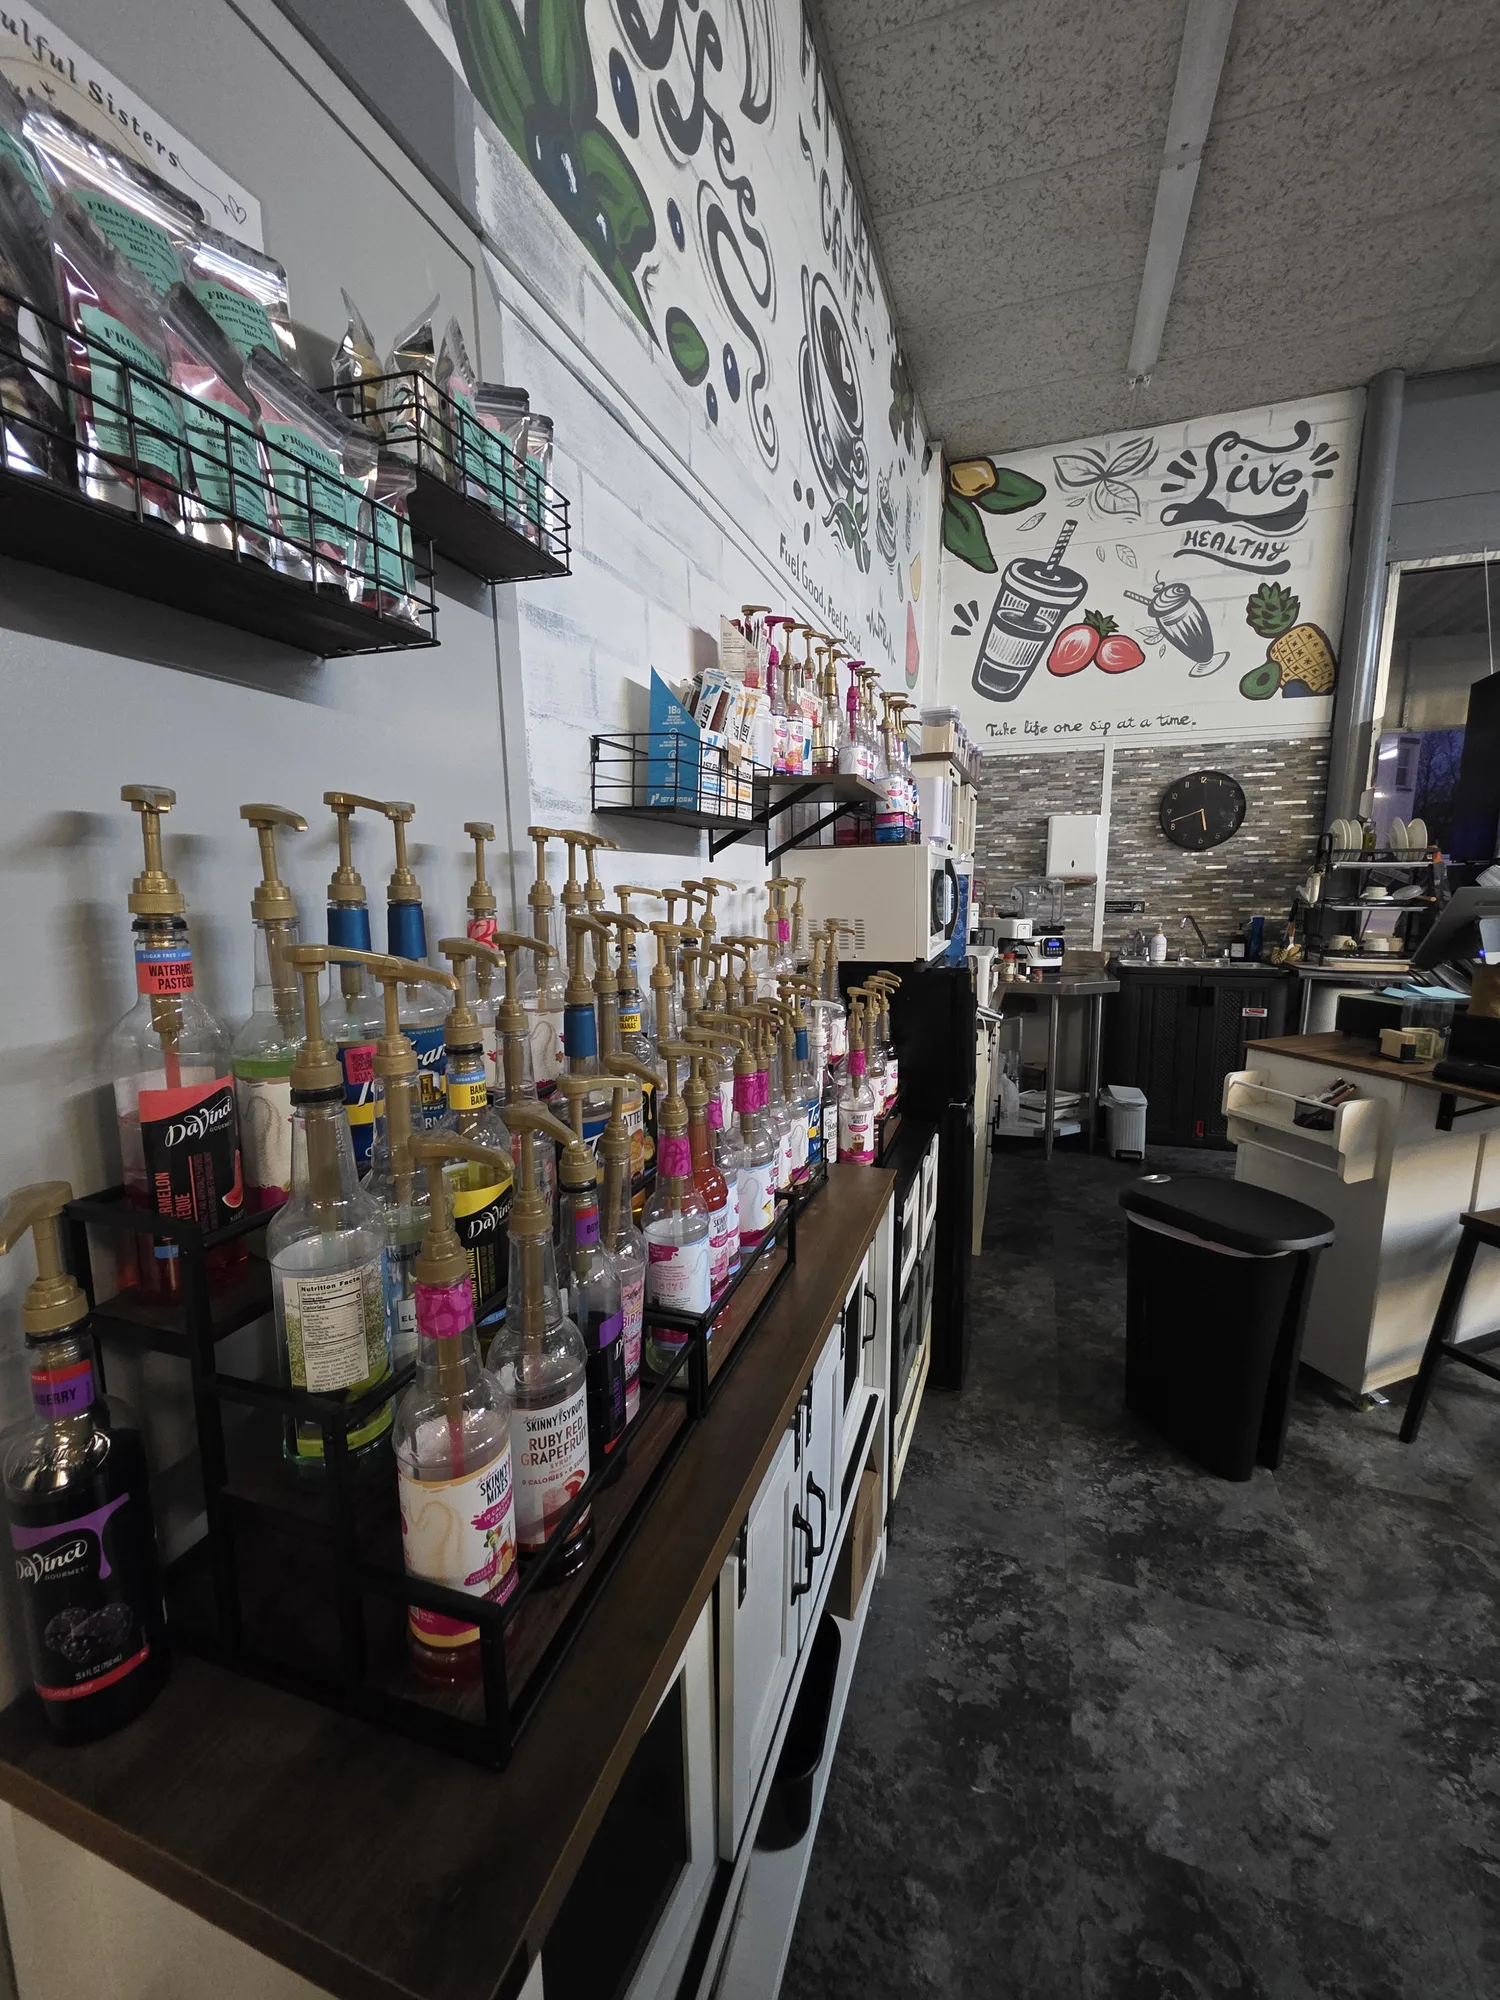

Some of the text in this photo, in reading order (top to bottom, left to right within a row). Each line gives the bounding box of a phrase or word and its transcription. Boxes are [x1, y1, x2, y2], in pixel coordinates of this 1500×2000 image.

[88, 79, 180, 167] Sisters
[818, 165, 864, 344] CAFE
[215, 313, 257, 332] Strawberry
[1160, 419, 1310, 532] Live
[1183, 530, 1290, 562] HEALTHY
[779, 532, 801, 582] Fuel
[801, 560, 827, 616] Good,
[827, 595, 843, 636] Feel
[985, 714, 1197, 737] Take life one sip at a time.
[1171, 792, 1178, 800] 10
[1229, 789, 1236, 797] 2
[1170, 823, 1176, 831] 8
[1227, 820, 1234, 828] 4
[620, 1014, 638, 1022] NEAPPLE
[164, 1095, 233, 1148] DaVinci
[209, 1119, 233, 1134] GOURMET
[301, 1276, 361, 1292] Nutrition Facts
[526, 1396, 585, 1432] SKINNY SYRUPS
[520, 1424, 587, 1466] GRAPEFRUIT
[528, 1416, 583, 1452] RUBY RED
[549, 1454, 572, 1470] SYRUP
[480, 1464, 509, 1497] SKINNY
[528, 1471, 563, 1486] CALORIES
[486, 1477, 509, 1507] MIXES
[15, 1539, 88, 1585] DaVinci
[44, 1567, 86, 1581] GOURMET
